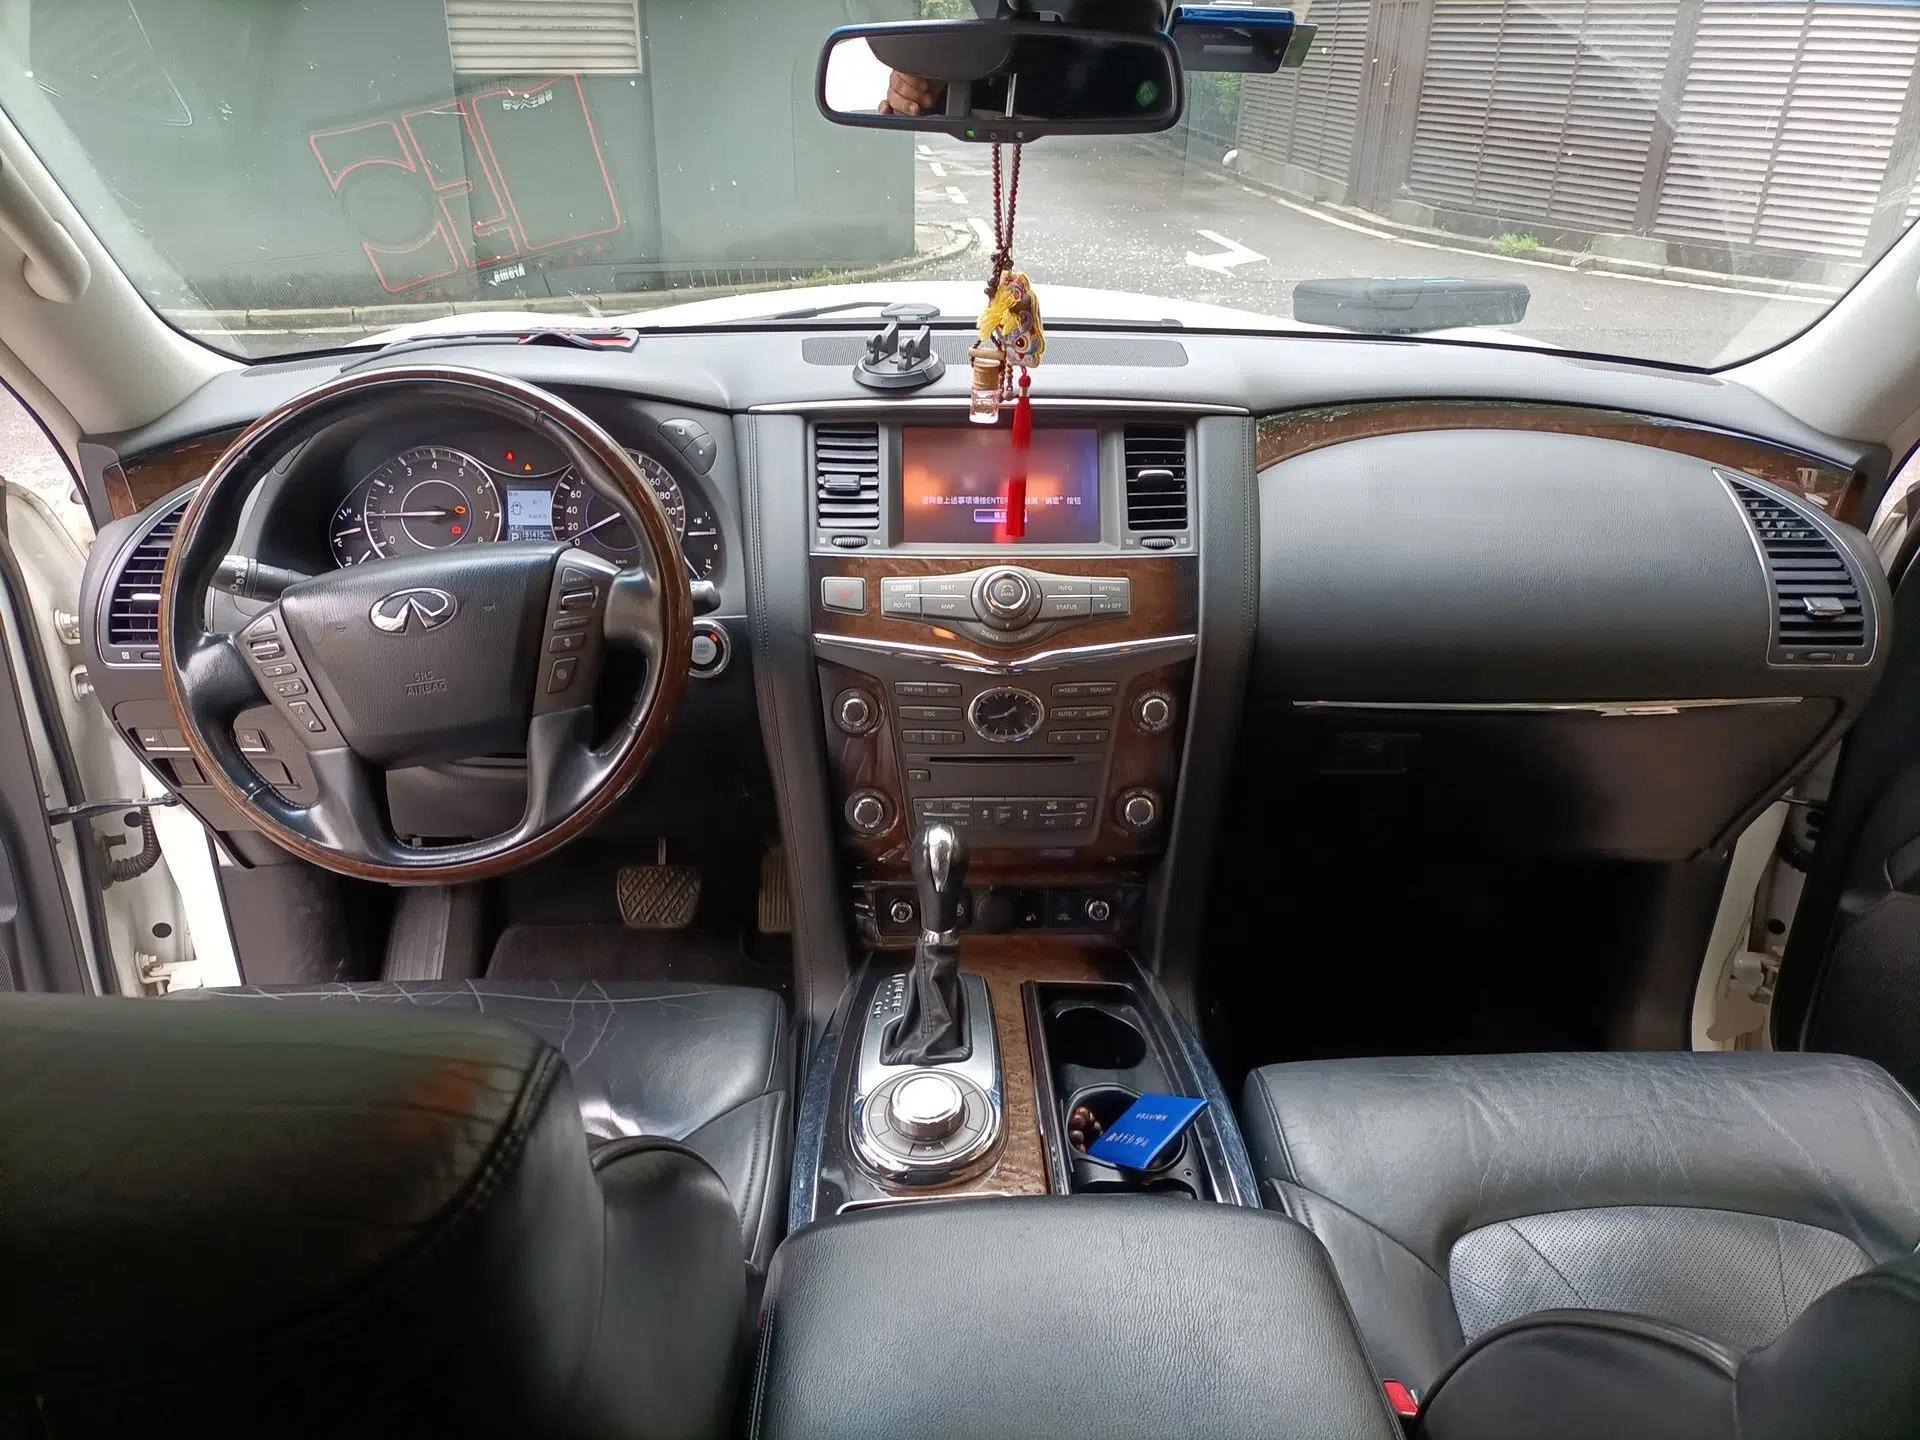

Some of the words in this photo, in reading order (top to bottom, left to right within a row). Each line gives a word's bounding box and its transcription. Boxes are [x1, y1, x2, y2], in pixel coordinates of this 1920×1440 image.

[432, 462, 438, 470] 4
[406, 468, 412, 476] 3
[389, 485, 394, 494] 2
[485, 511, 490, 519] 7
[390, 536, 395, 544] 0
[511, 533, 519, 541] P
[414, 671, 433, 681] SRS
[406, 680, 447, 696] AIRBAG
